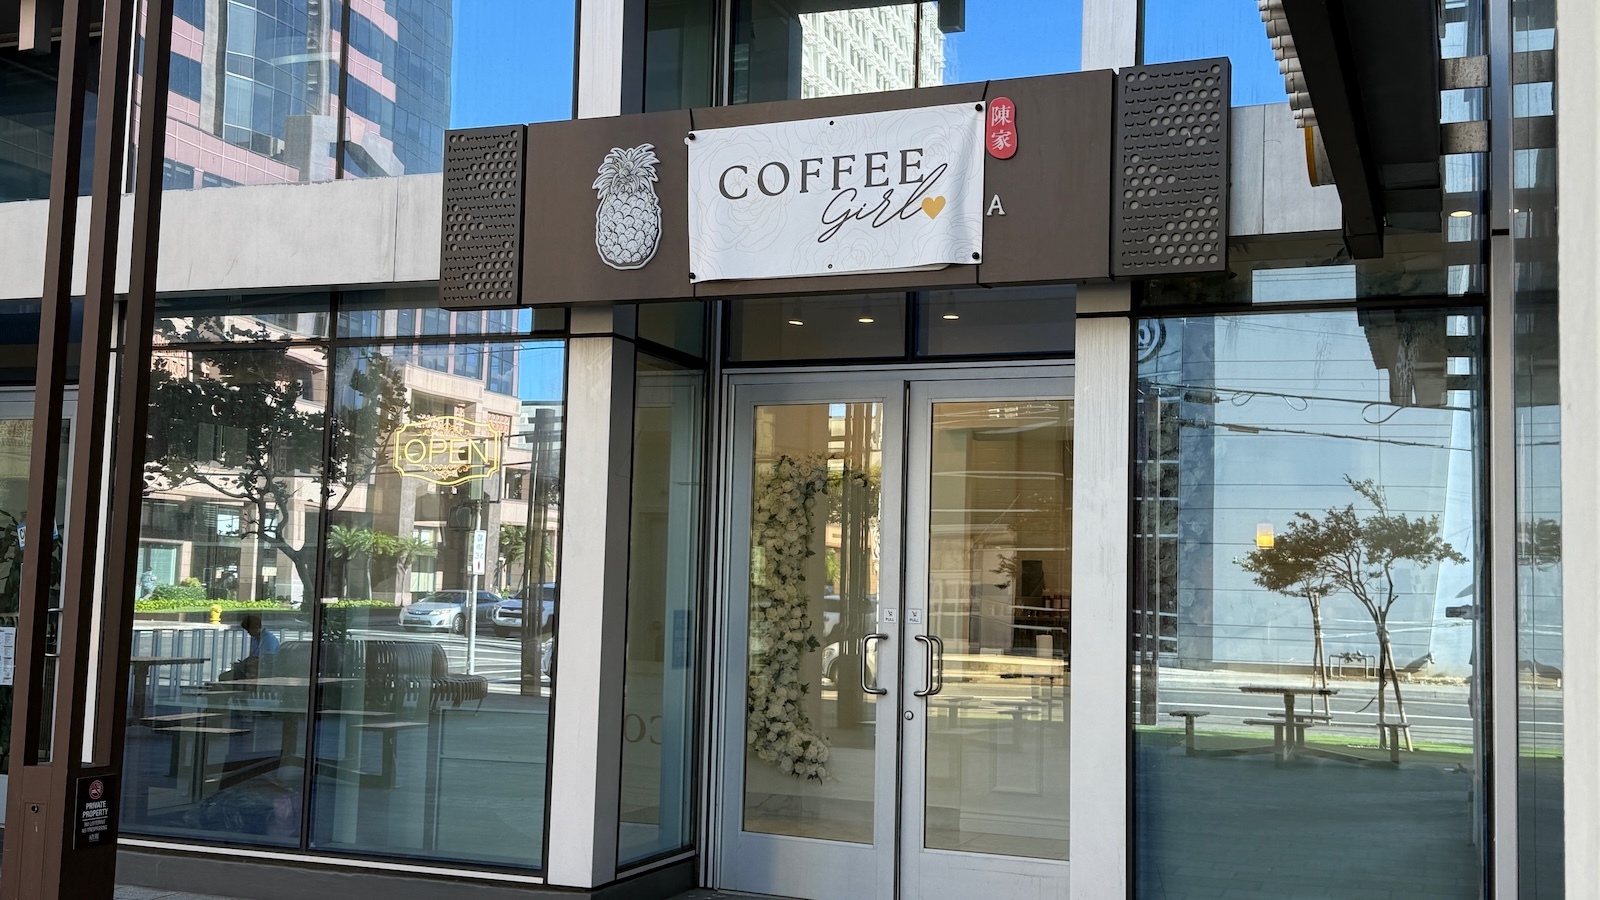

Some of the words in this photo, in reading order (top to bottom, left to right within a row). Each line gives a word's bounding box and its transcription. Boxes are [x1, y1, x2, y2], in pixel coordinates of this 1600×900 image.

[990, 104, 1012, 151] 陳家
[718, 147, 925, 201] COFFEE
[817, 162, 948, 244] Girl
[404, 438, 490, 464] OPEN
[82, 808, 108, 818] PROPERTY
[85, 800, 107, 810] PRIVATE
